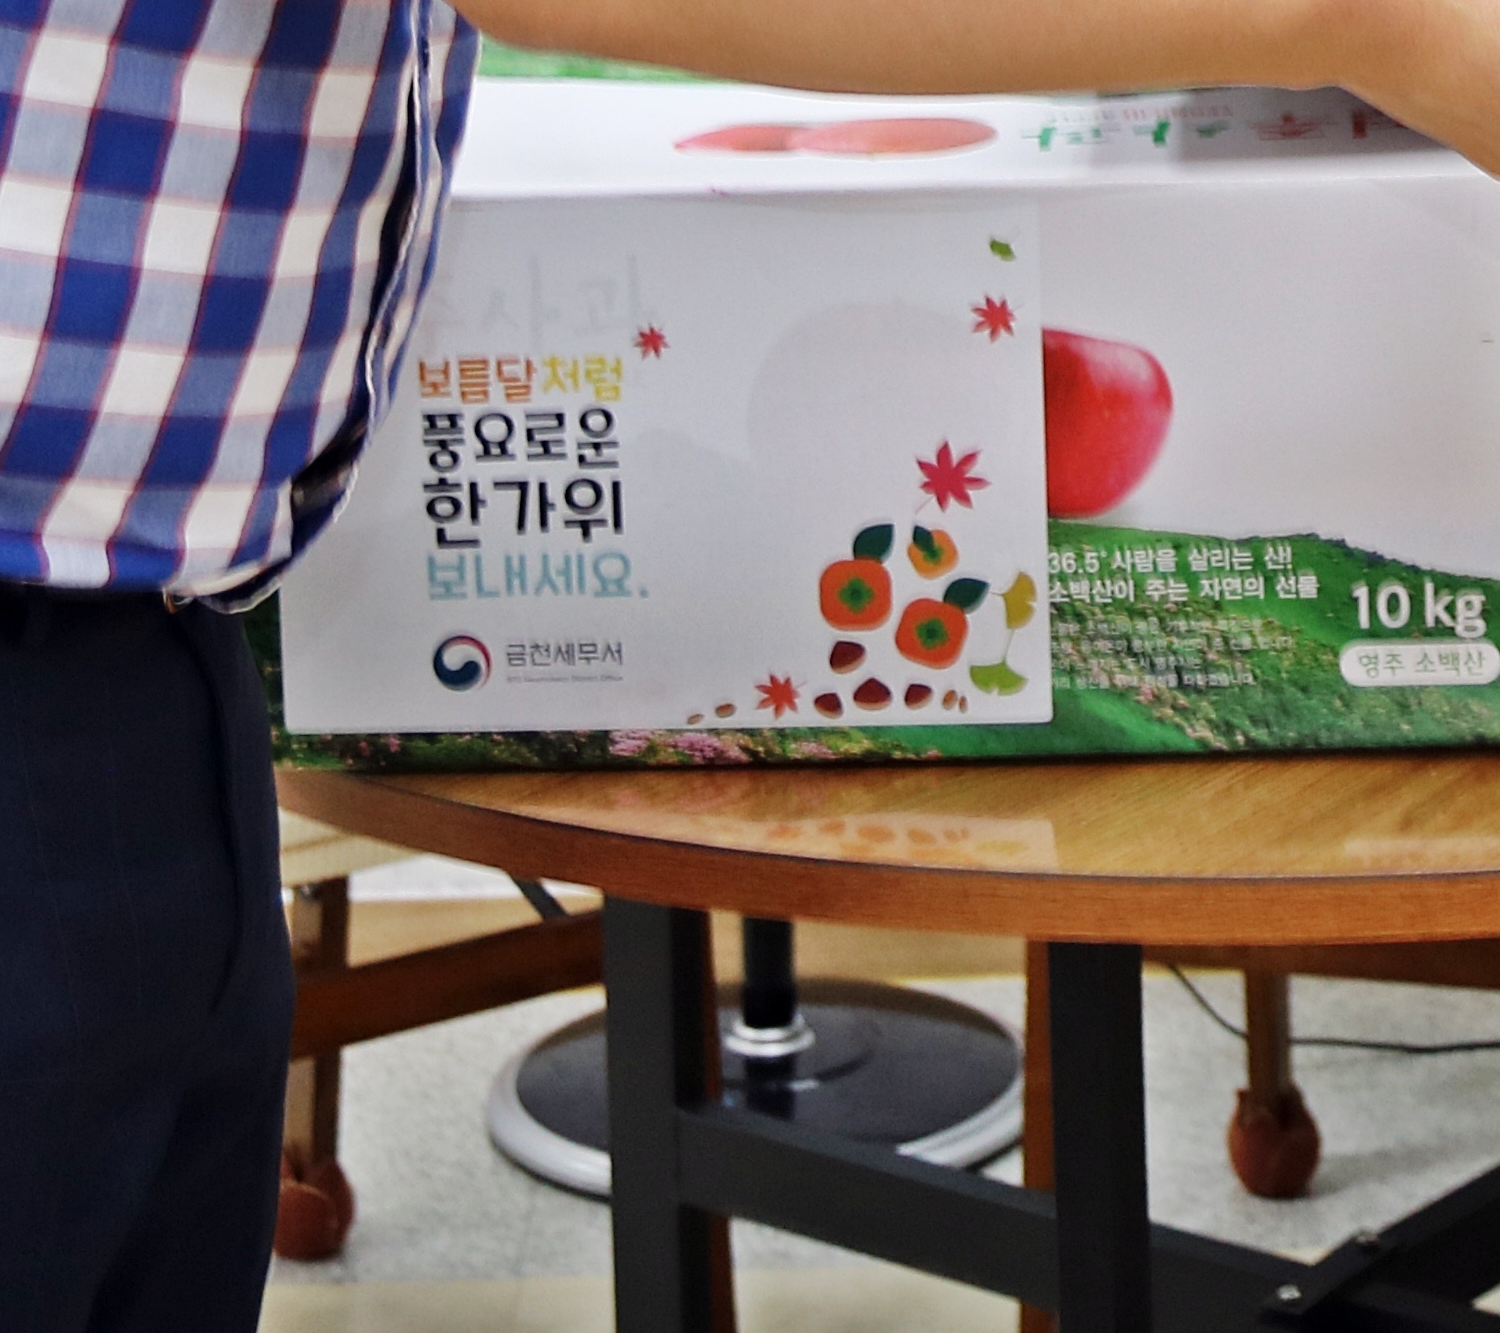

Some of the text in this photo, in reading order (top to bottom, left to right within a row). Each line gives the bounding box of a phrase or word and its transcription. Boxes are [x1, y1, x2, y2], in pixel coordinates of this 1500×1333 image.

[418, 356, 624, 404] 보름달처럼
[422, 408, 621, 474] 풍요로운
[422, 477, 624, 550] 한가위
[426, 551, 650, 601] 보내세요.
[1188, 544, 1254, 572] 살리는
[1264, 542, 1293, 571] 산!
[1049, 574, 1320, 604] 소백산이 주는 자연의 선물
[1352, 577, 1488, 639] 10 kg
[506, 641, 624, 667] 금천세무서
[1358, 651, 1486, 679] 영주 소백산
